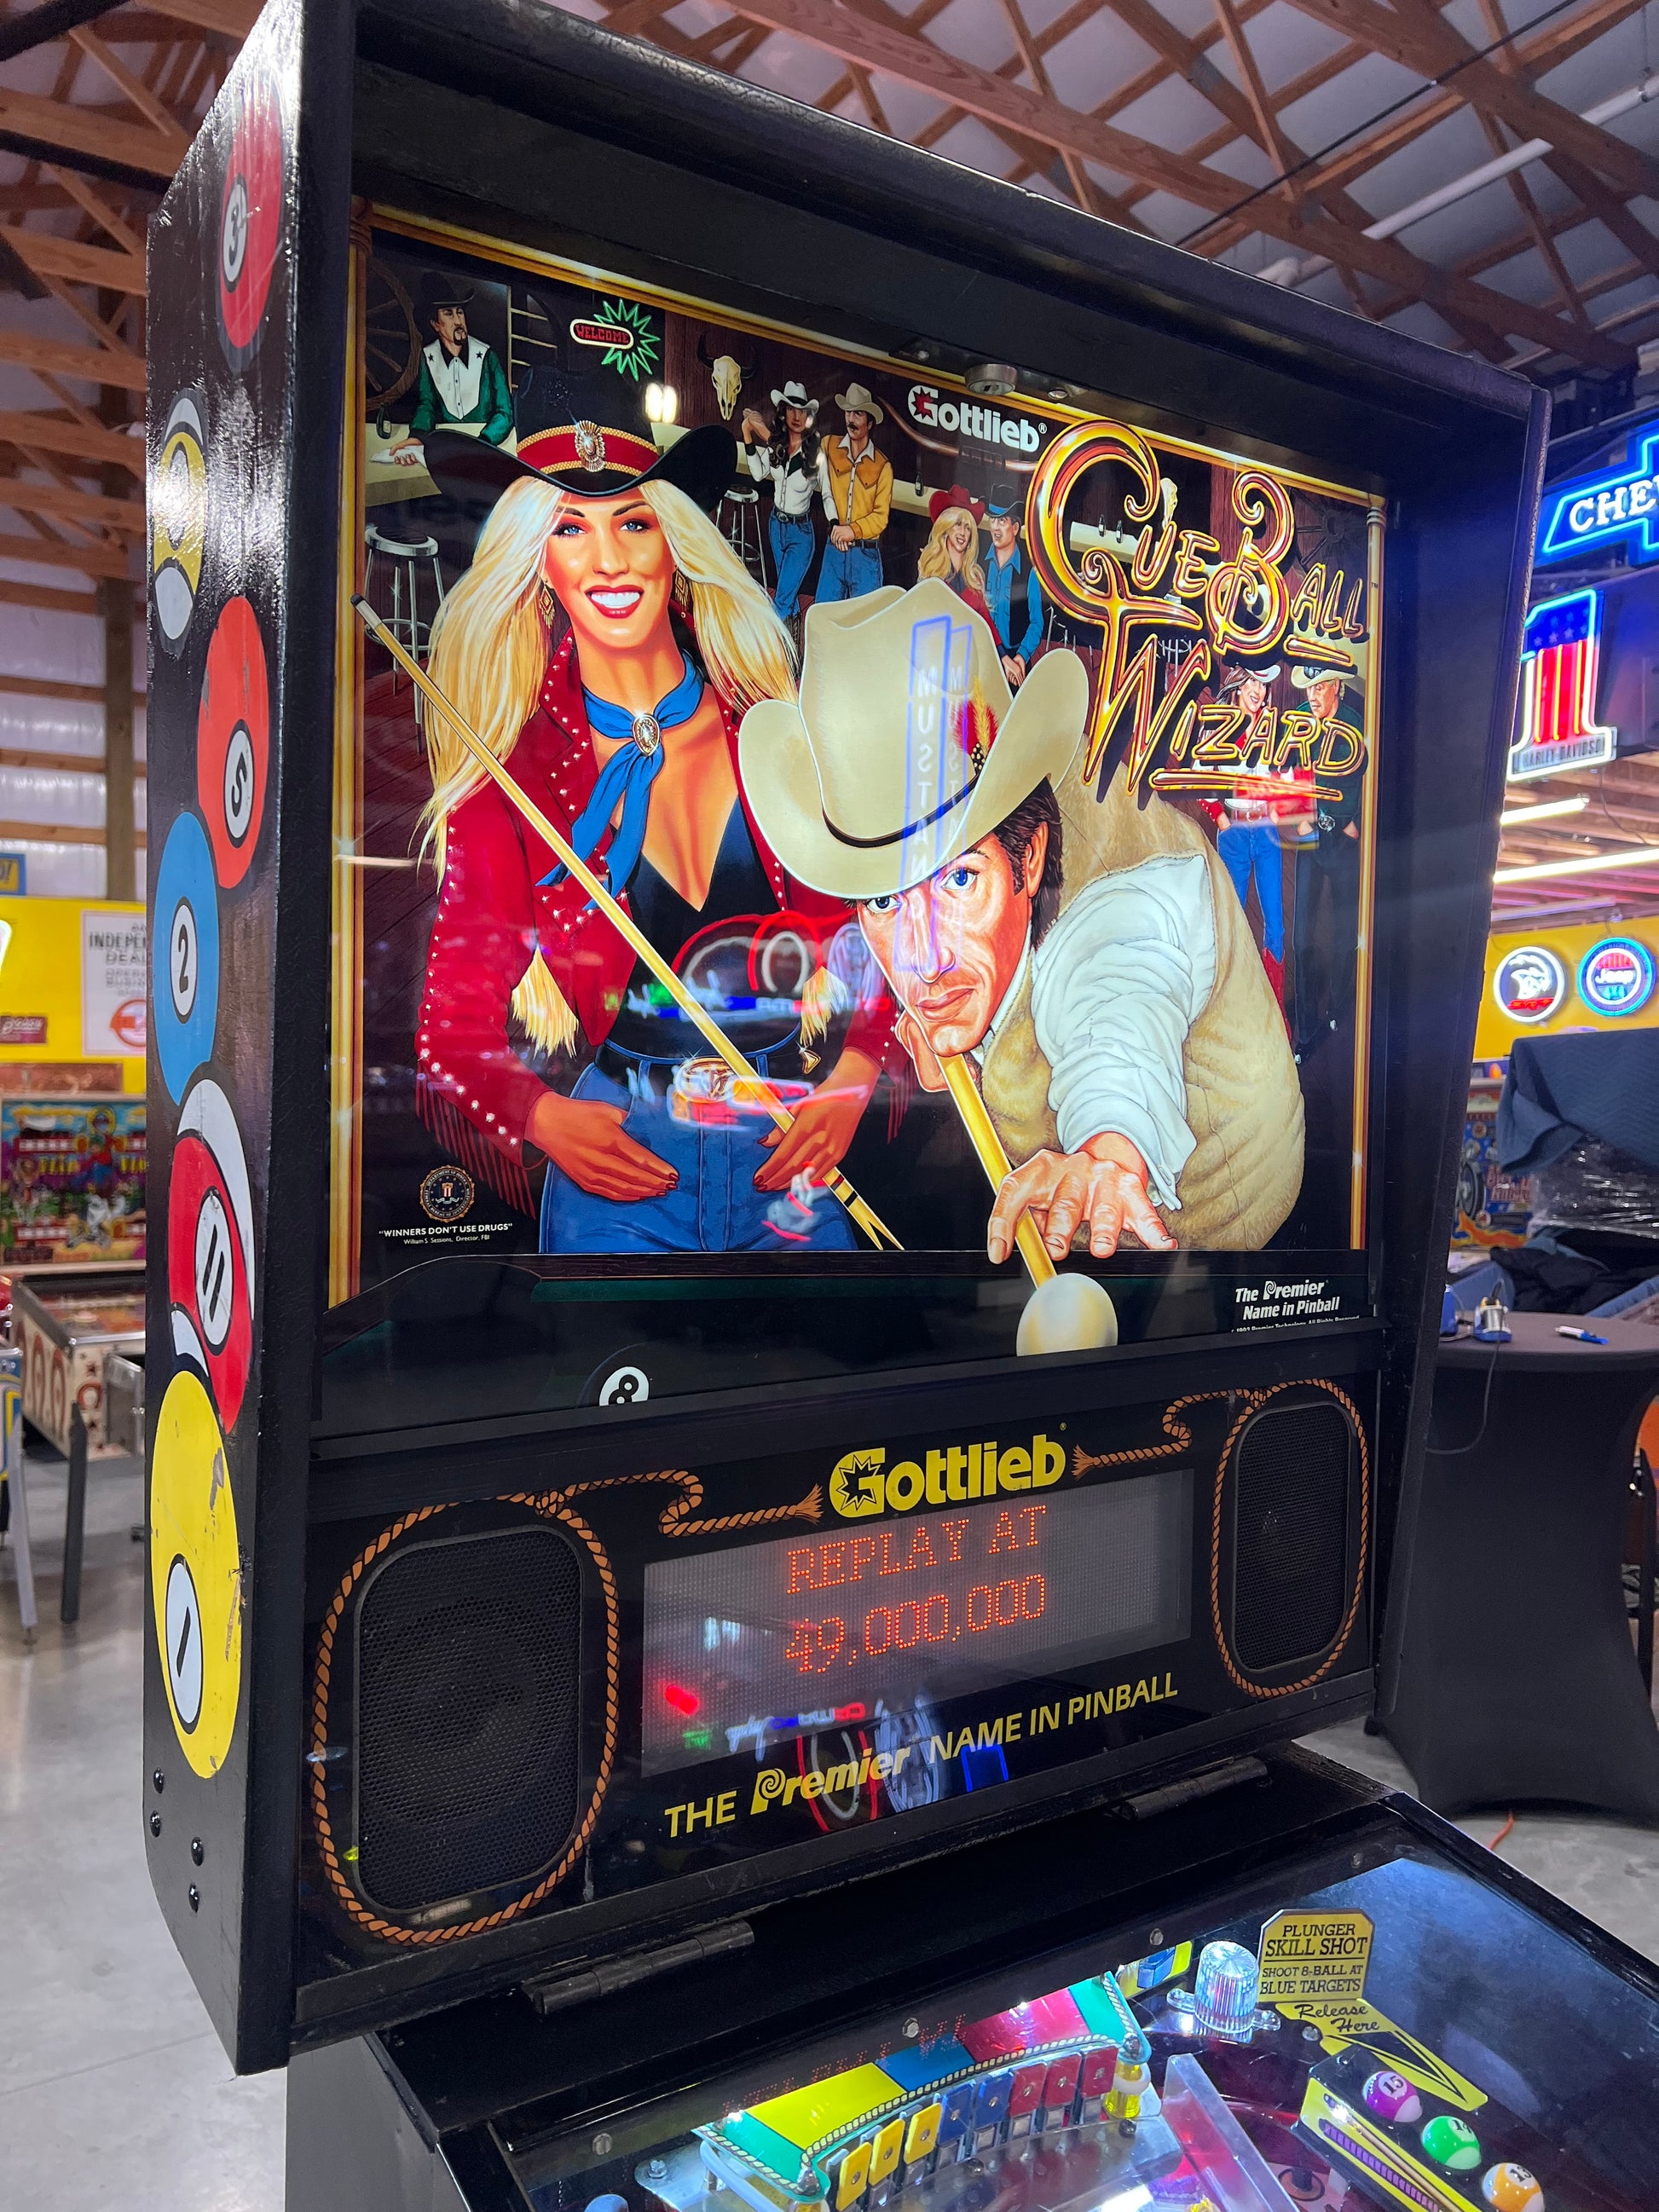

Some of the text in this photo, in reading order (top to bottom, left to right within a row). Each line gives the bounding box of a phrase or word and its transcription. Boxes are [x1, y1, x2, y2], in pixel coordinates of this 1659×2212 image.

[575, 323, 629, 344] WELCOME
[1081, 597, 1369, 798] WIZARD
[177, 923, 189, 994] 2
[428, 1226, 458, 1235] DON'T
[459, 1225, 477, 1233] USE
[1235, 1279, 1325, 1303] The Premier
[1243, 1297, 1340, 1320] Name in Pinball
[830, 1434, 1066, 1518] Gottlieb
[786, 1505, 1048, 1595] REPLAY AT
[785, 1574, 1046, 1673] 49,000,000
[664, 1672, 1178, 1838] THE Premier NAME IN PINBALL
[1282, 1923, 1356, 1938] PLUNGER
[1264, 1937, 1368, 1957] SKILL SHOT
[1262, 1965, 1363, 1978] SHOOT 8-BALL AT
[1259, 1978, 1361, 1995] BLUE TARGETS
[1293, 2004, 1369, 2019] Release
[1330, 2017, 1380, 2033] Here
[1382, 2075, 1405, 2094] 15
